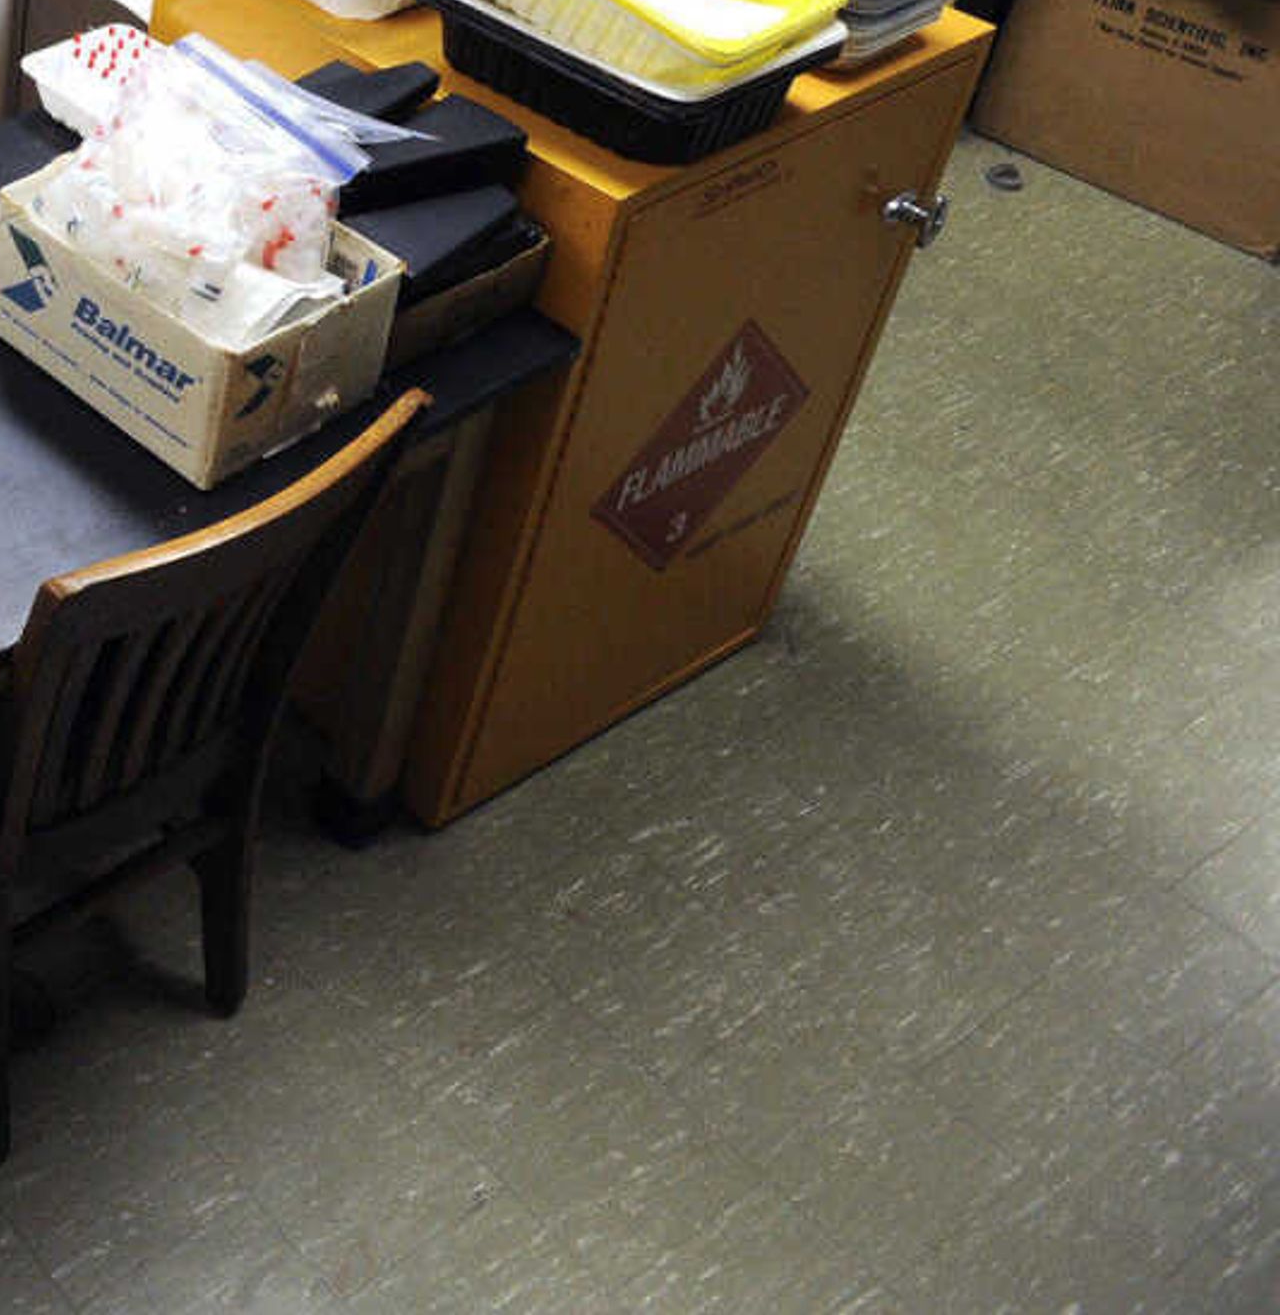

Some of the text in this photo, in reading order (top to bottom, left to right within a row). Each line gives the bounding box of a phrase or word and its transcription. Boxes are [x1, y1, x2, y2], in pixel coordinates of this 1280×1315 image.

[72, 296, 197, 390] Balmar
[617, 393, 790, 511] FLAMMABLE
[665, 510, 687, 544] 3
